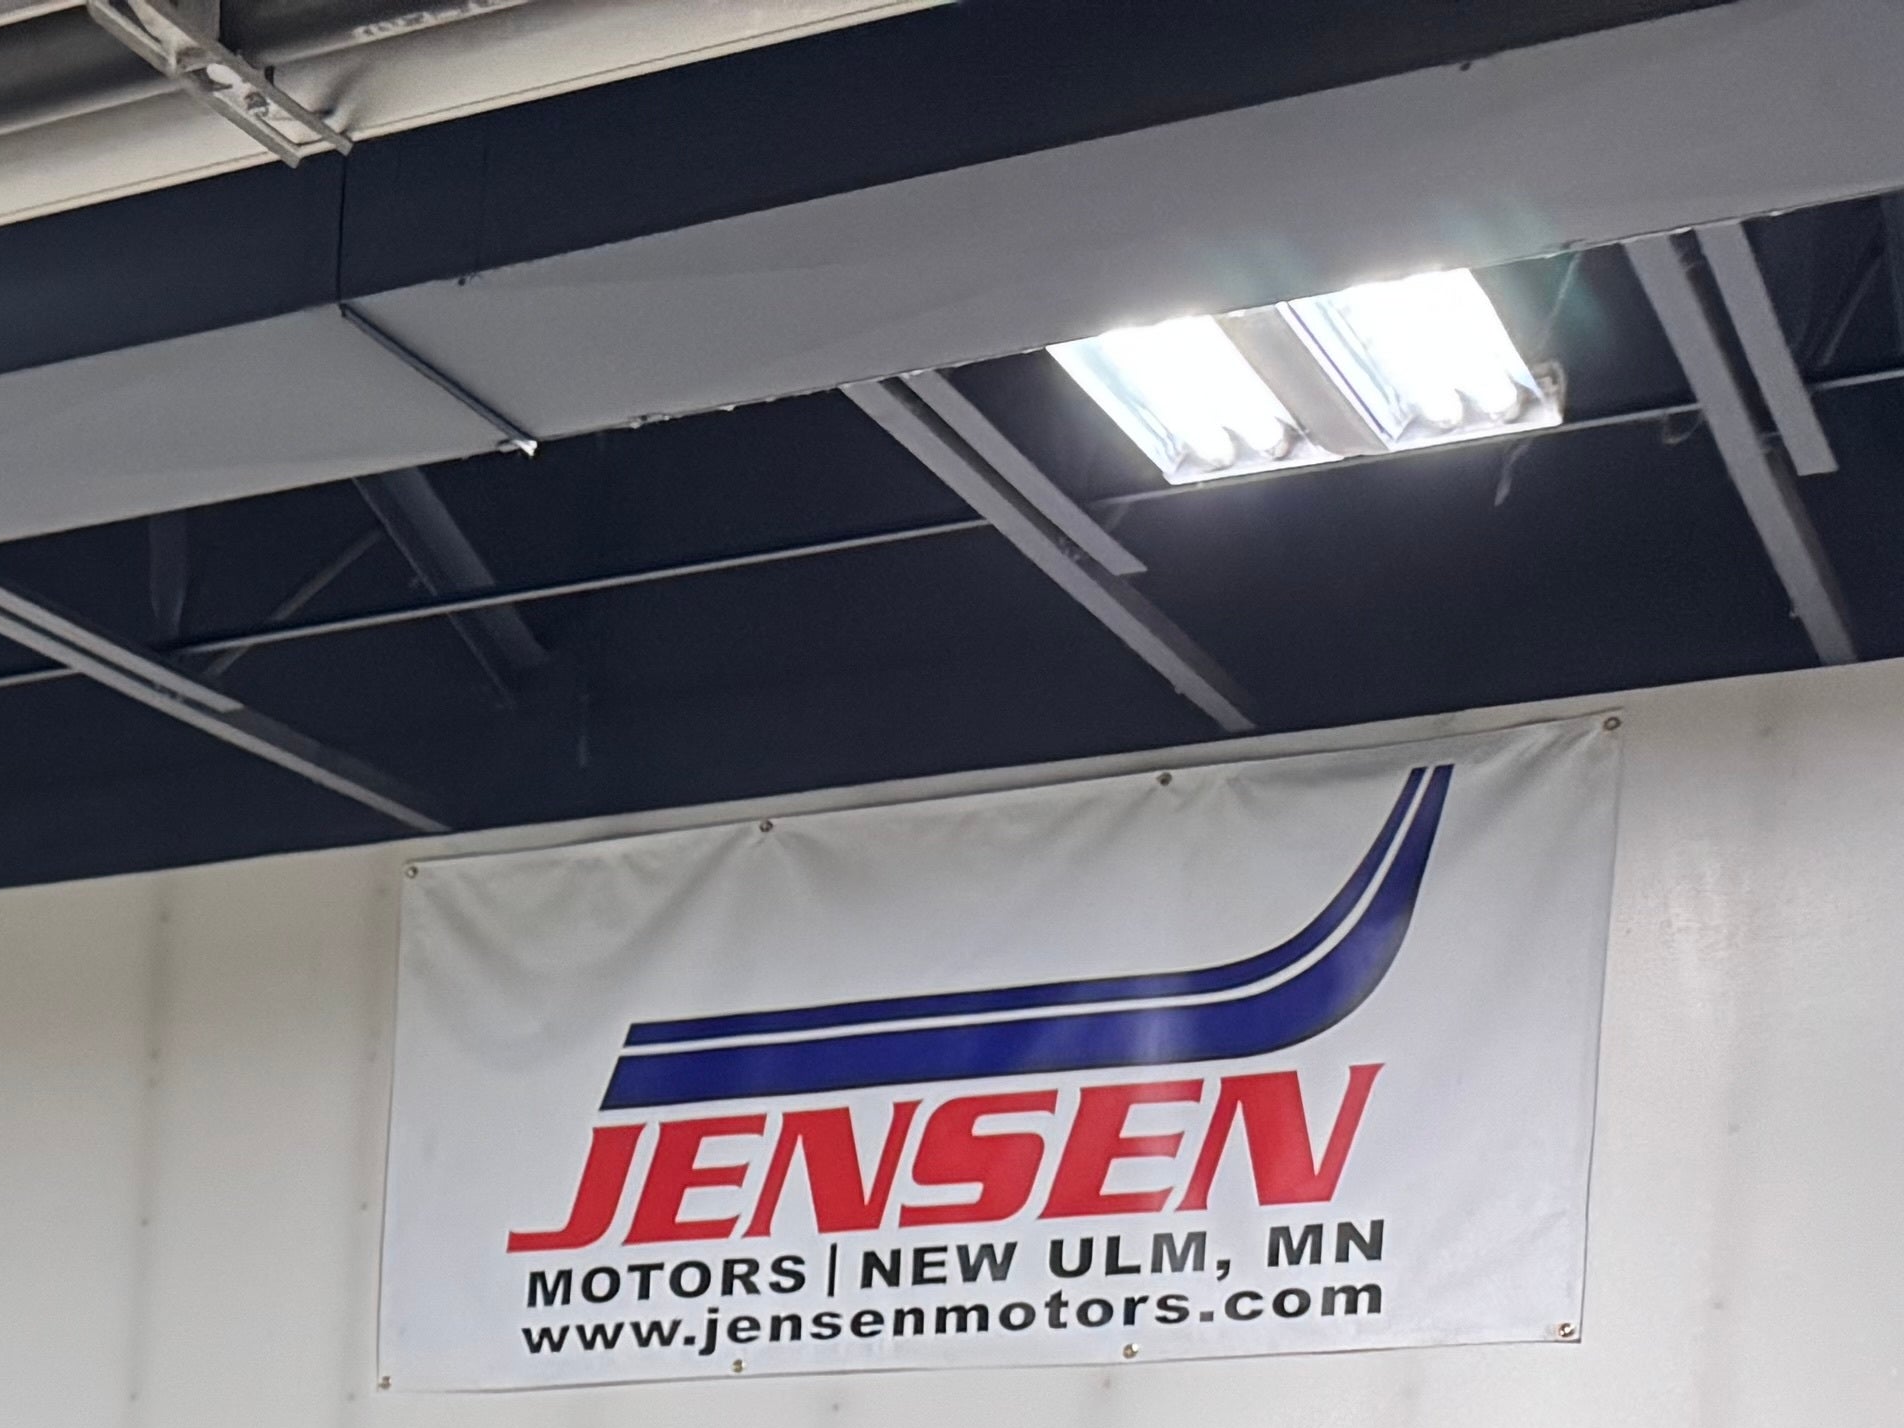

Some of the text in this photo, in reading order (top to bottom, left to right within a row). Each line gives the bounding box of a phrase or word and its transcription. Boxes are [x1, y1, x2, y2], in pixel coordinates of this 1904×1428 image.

[507, 1063, 1384, 1252] JENSEN
[527, 1219, 1384, 1307] MOTORS NEW ULM, MN
[521, 1284, 1382, 1356] www.jensenmotors.com
